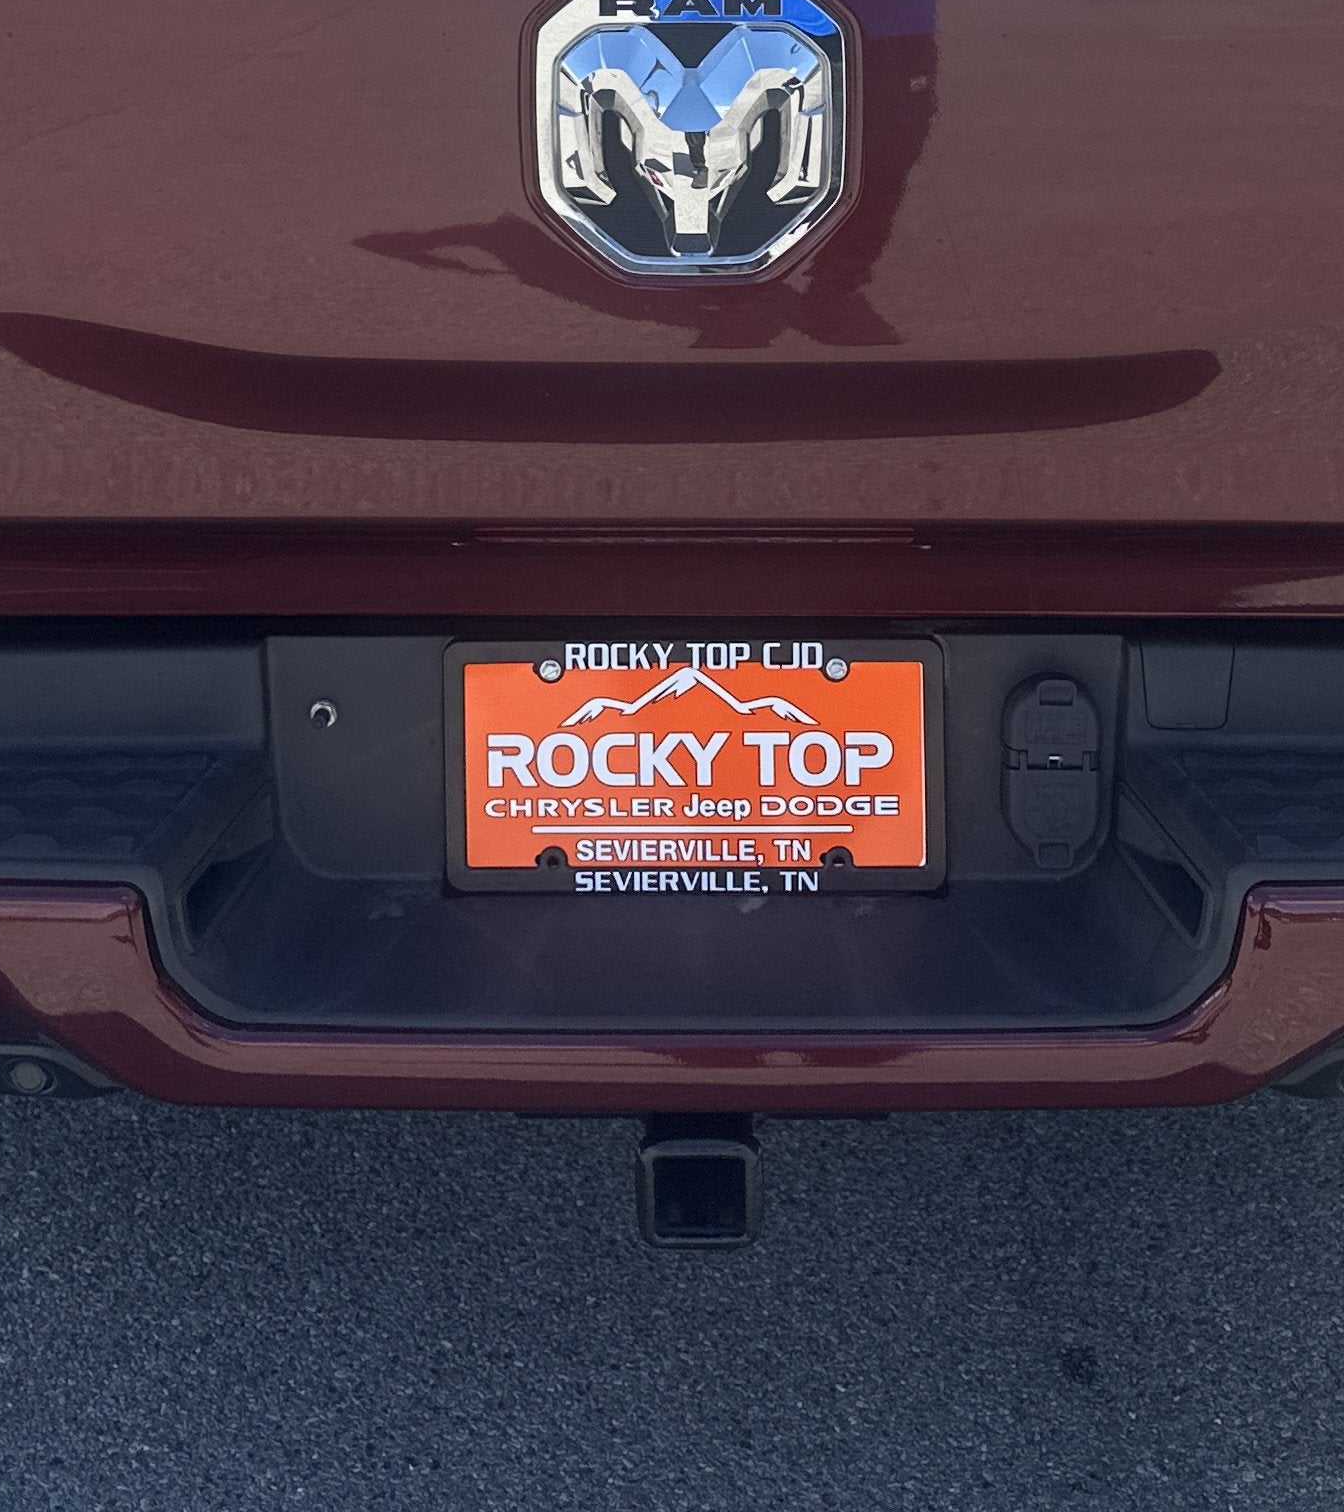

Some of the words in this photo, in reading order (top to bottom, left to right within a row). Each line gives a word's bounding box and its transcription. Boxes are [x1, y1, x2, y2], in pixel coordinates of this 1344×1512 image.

[564, 642, 674, 671] ROCKY
[686, 642, 751, 671] TOP
[762, 641, 824, 671] CJD
[486, 731, 730, 788] ROCKY
[742, 731, 895, 788] TOP
[484, 797, 676, 819] CHRYSLER
[682, 793, 752, 821] Jeep
[760, 796, 901, 817] DODGE
[575, 838, 765, 865] SEVIERVILLE,
[772, 838, 813, 862] TN
[574, 871, 770, 895] SEVIERVILLE,
[778, 871, 821, 892] TN
